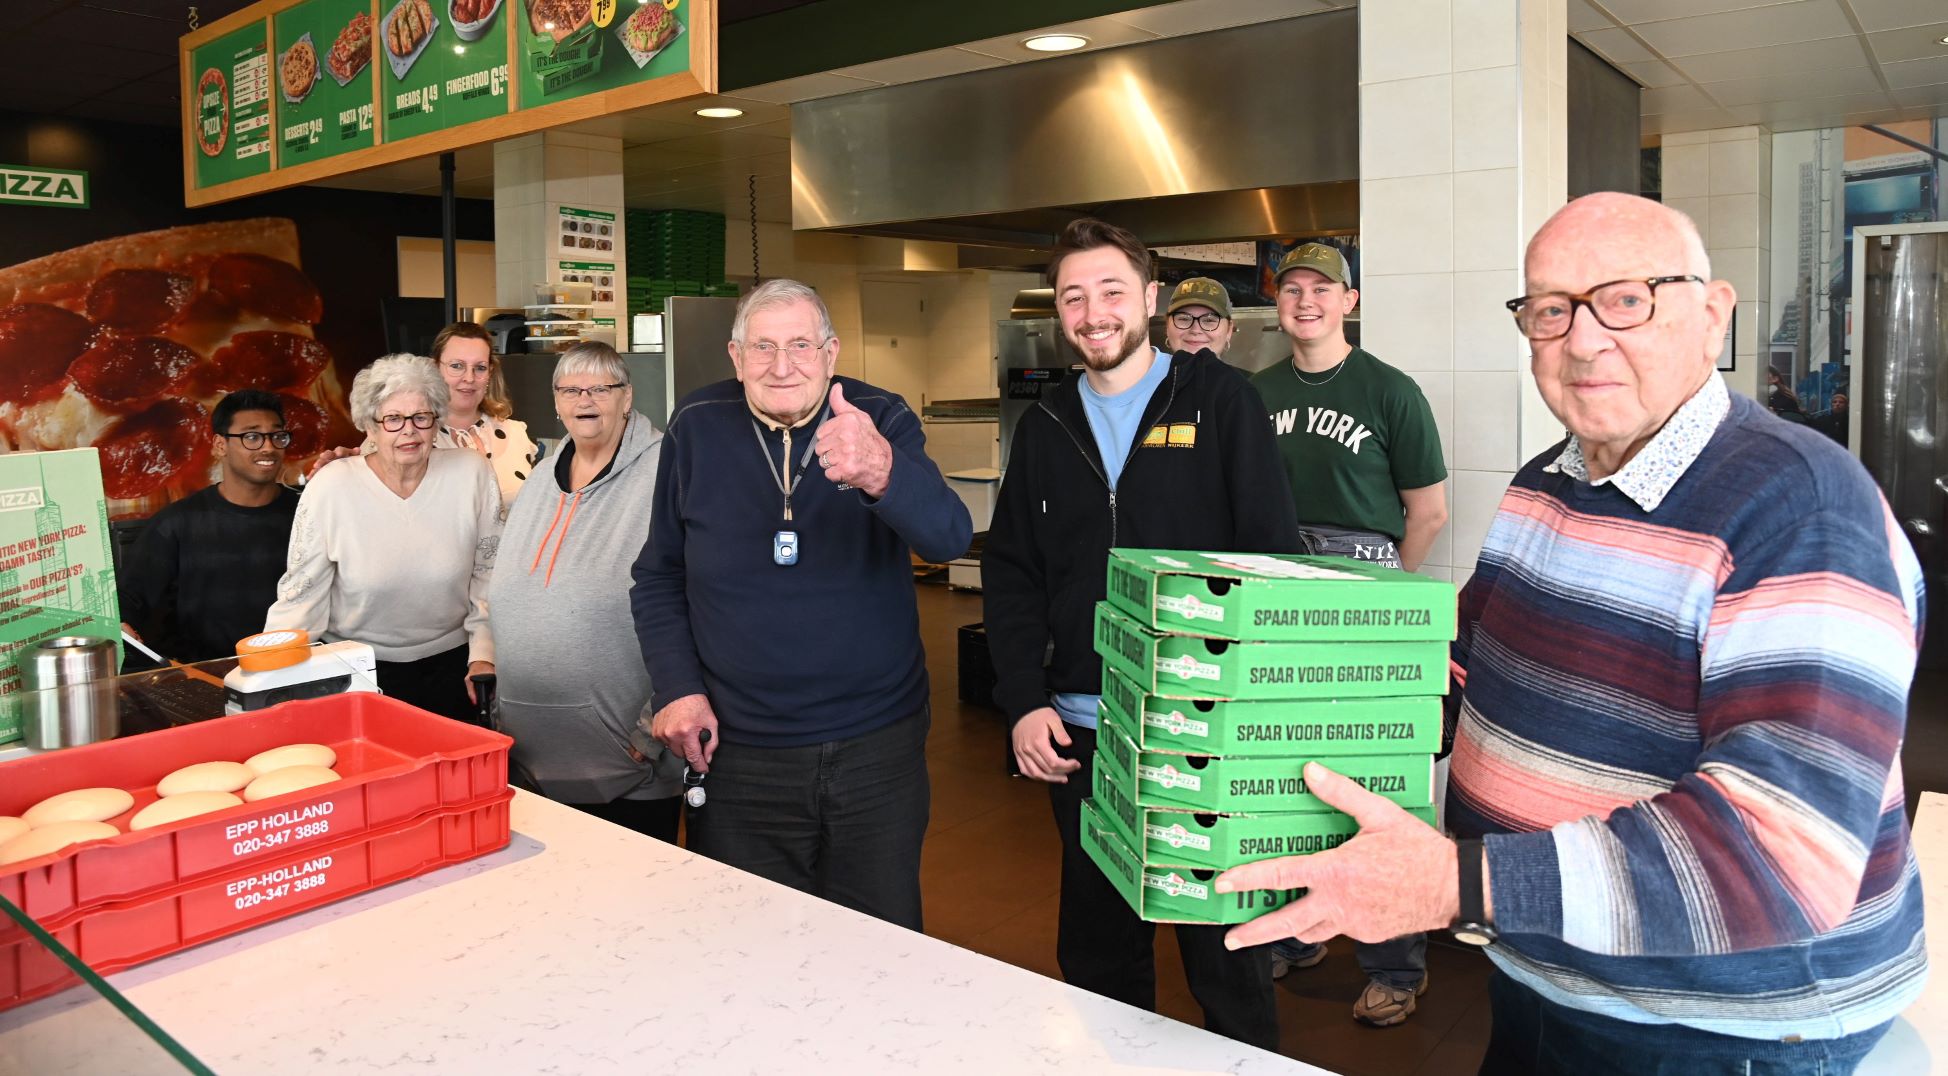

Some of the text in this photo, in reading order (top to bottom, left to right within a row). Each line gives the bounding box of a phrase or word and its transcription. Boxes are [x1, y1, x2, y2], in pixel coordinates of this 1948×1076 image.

[446, 70, 489, 95] FINGERFOOD
[396, 90, 421, 110] BREADS
[204, 116, 221, 136] PIZZA
[340, 108, 357, 125] PASTA
[285, 122, 309, 141] DESSERTS
[1181, 282, 1218, 296] NYP
[1306, 406, 1372, 455] YORK
[18, 538, 37, 553] NEW
[38, 531, 60, 546] YORK
[62, 524, 87, 540] PIZZA:
[27, 546, 55, 563] TASTY!
[30, 575, 48, 590] OUR
[1254, 609, 1431, 626] SPAAR VOOR GRATIS PIZZA
[1250, 664, 1422, 684] SPAAR VOOR GRATIS PIZZA
[1237, 723, 1415, 741] SPAAR VOOR GRATIS PIZZA
[1231, 778, 1274, 796] SPAAR
[1370, 775, 1406, 792] PIZZA
[226, 801, 334, 840] EPP HOLLAND
[233, 820, 329, 856] 020-347 3888
[1239, 838, 1283, 855] SPAAR
[1287, 835, 1323, 852] VOOR
[226, 856, 332, 896] EPP-HOLLAND
[235, 873, 326, 910] 020-347 3888
